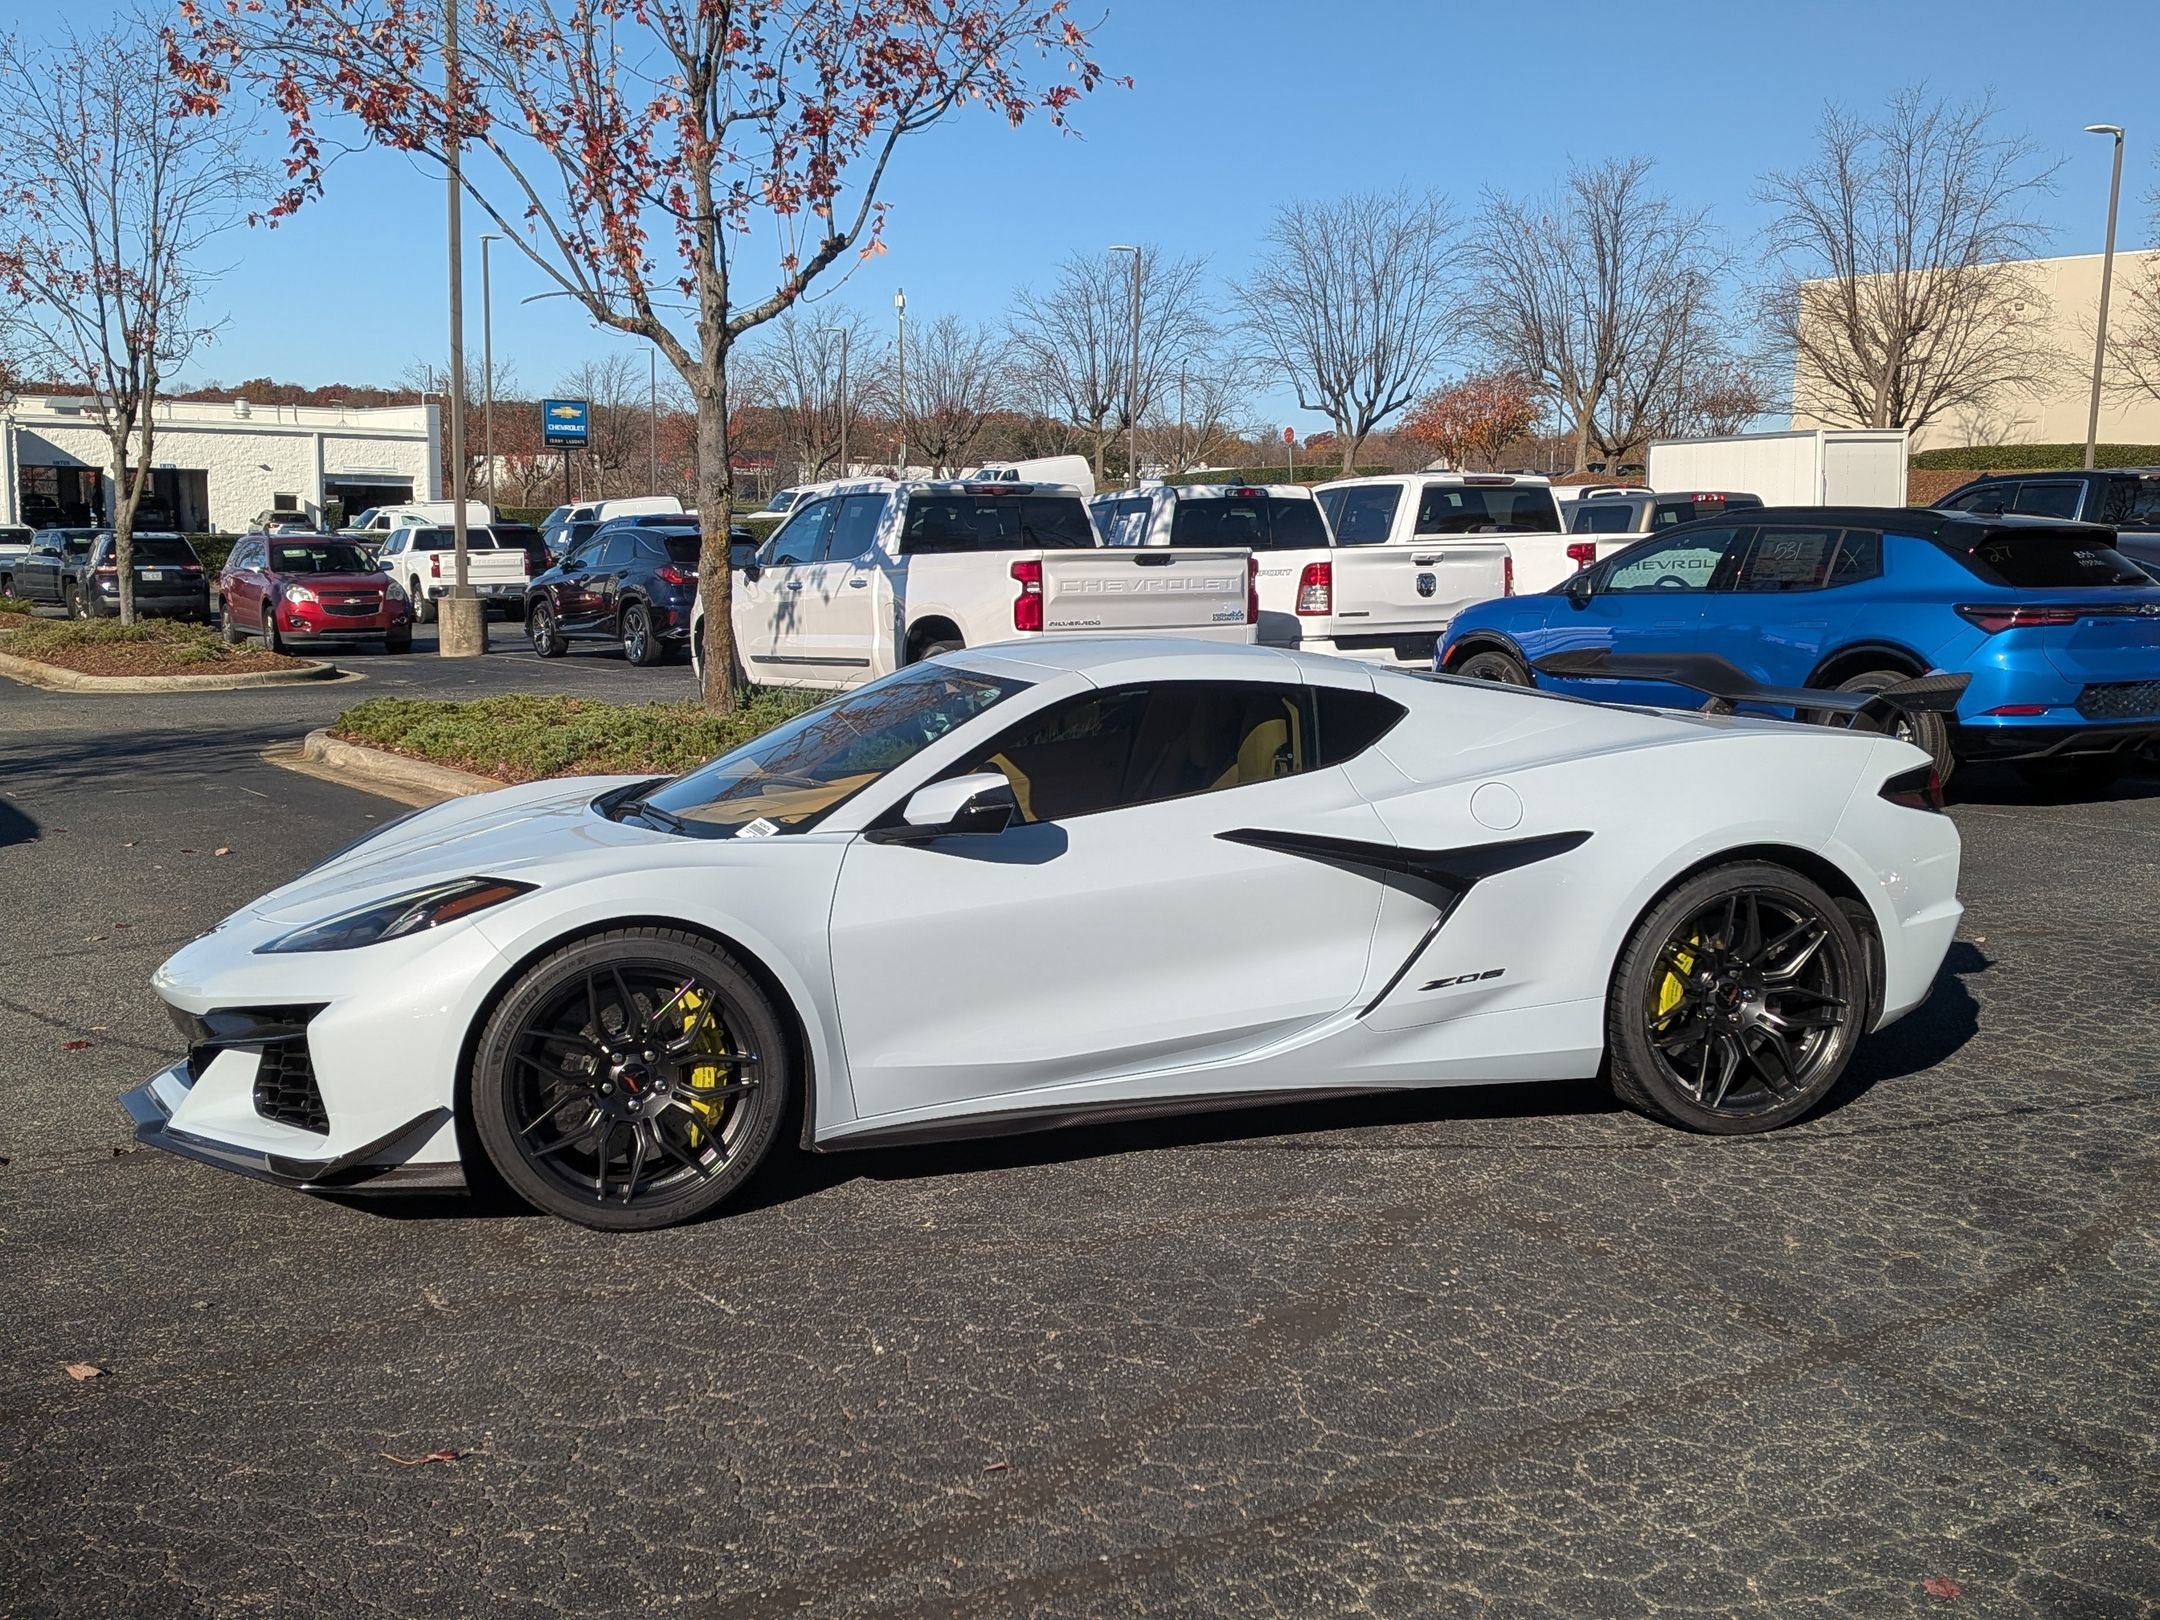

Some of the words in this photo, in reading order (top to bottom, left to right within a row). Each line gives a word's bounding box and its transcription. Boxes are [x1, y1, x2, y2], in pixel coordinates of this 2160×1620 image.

[1258, 568, 1293, 576] PORT
[1625, 560, 1720, 571] HEVROL
[1060, 577, 1238, 593] CHEVROLET
[1417, 968, 1506, 991] Z06
[498, 989, 538, 1051] MICHELIN
